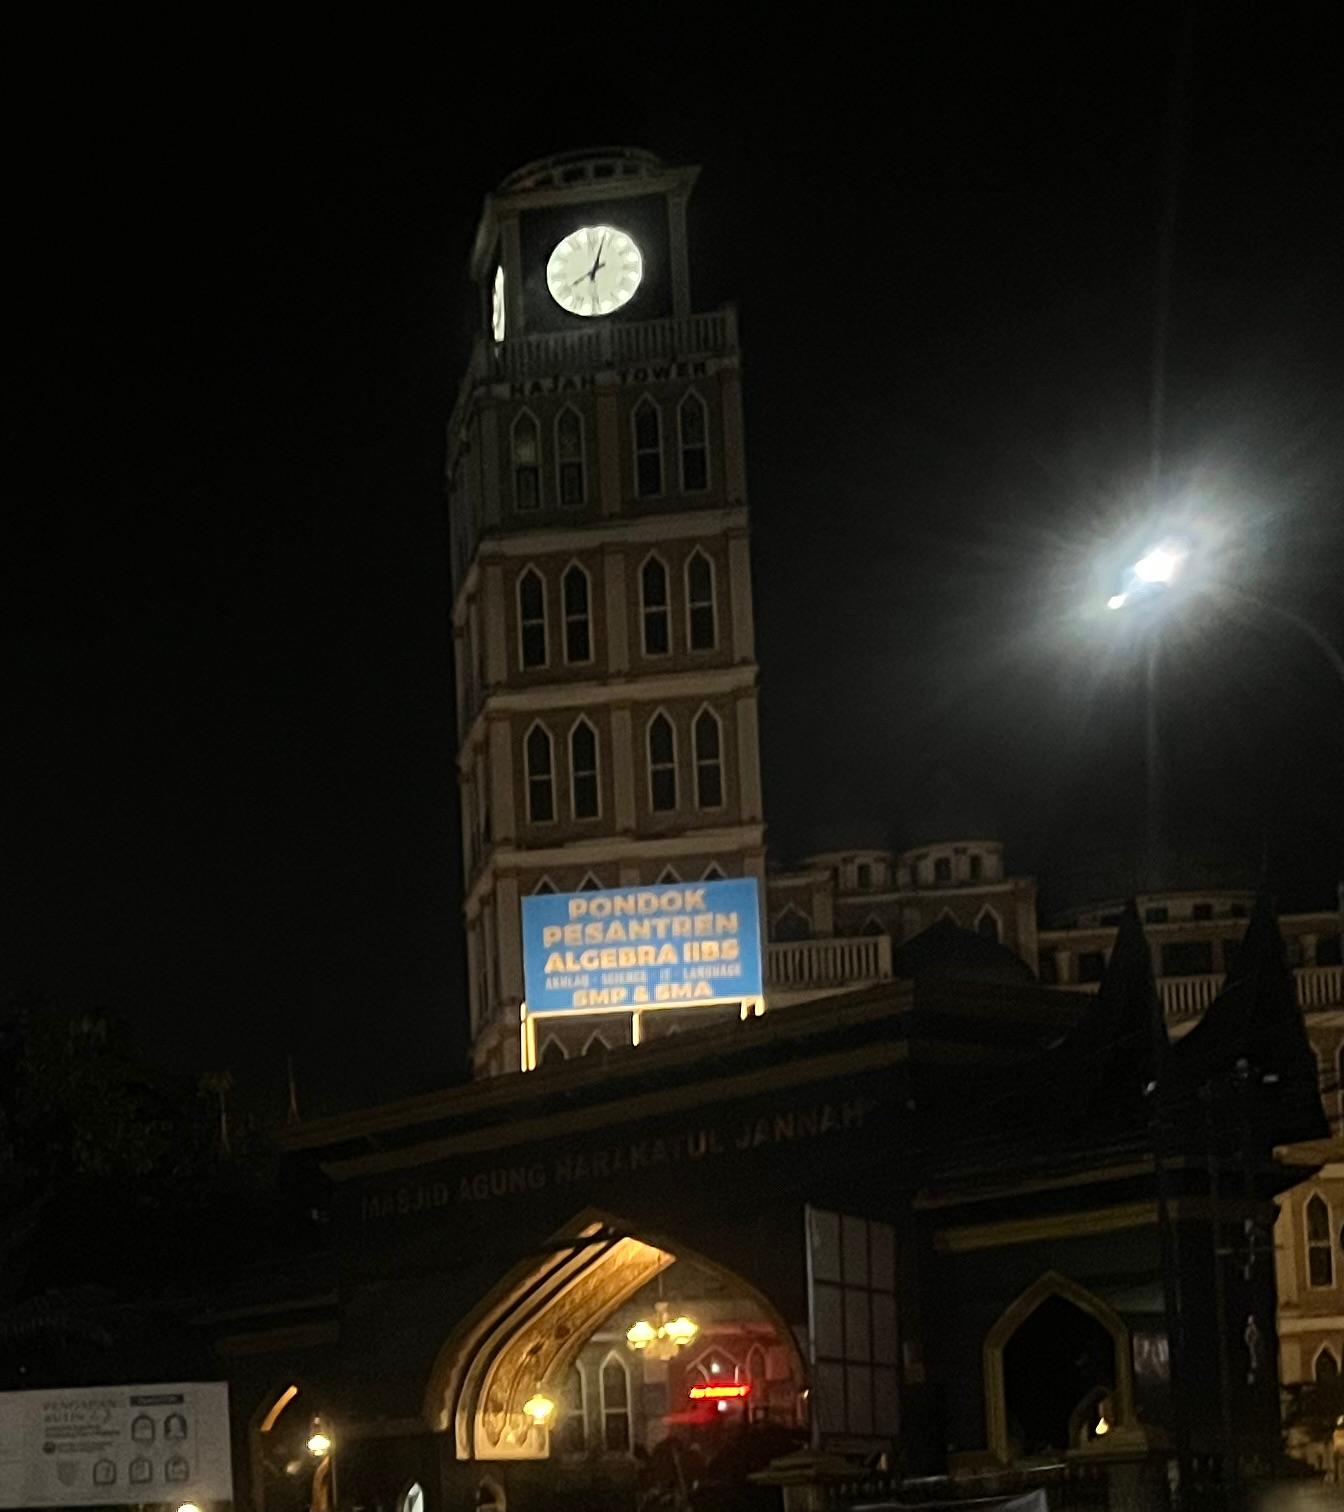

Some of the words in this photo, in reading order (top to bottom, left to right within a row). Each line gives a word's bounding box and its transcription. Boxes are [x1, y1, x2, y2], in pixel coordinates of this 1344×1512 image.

[509, 373, 596, 397] HAJAH
[620, 362, 709, 385] TOWER
[569, 890, 706, 920] PONDOK
[543, 912, 739, 948] PESANTREN
[544, 943, 677, 973] ALGEBRA
[574, 987, 628, 1006] SMP
[634, 985, 648, 1003] &
[656, 980, 712, 1001] SMA
[359, 1184, 449, 1220] MASJID
[458, 1162, 547, 1203] AGUNG
[735, 1101, 865, 1150] JANNAH
